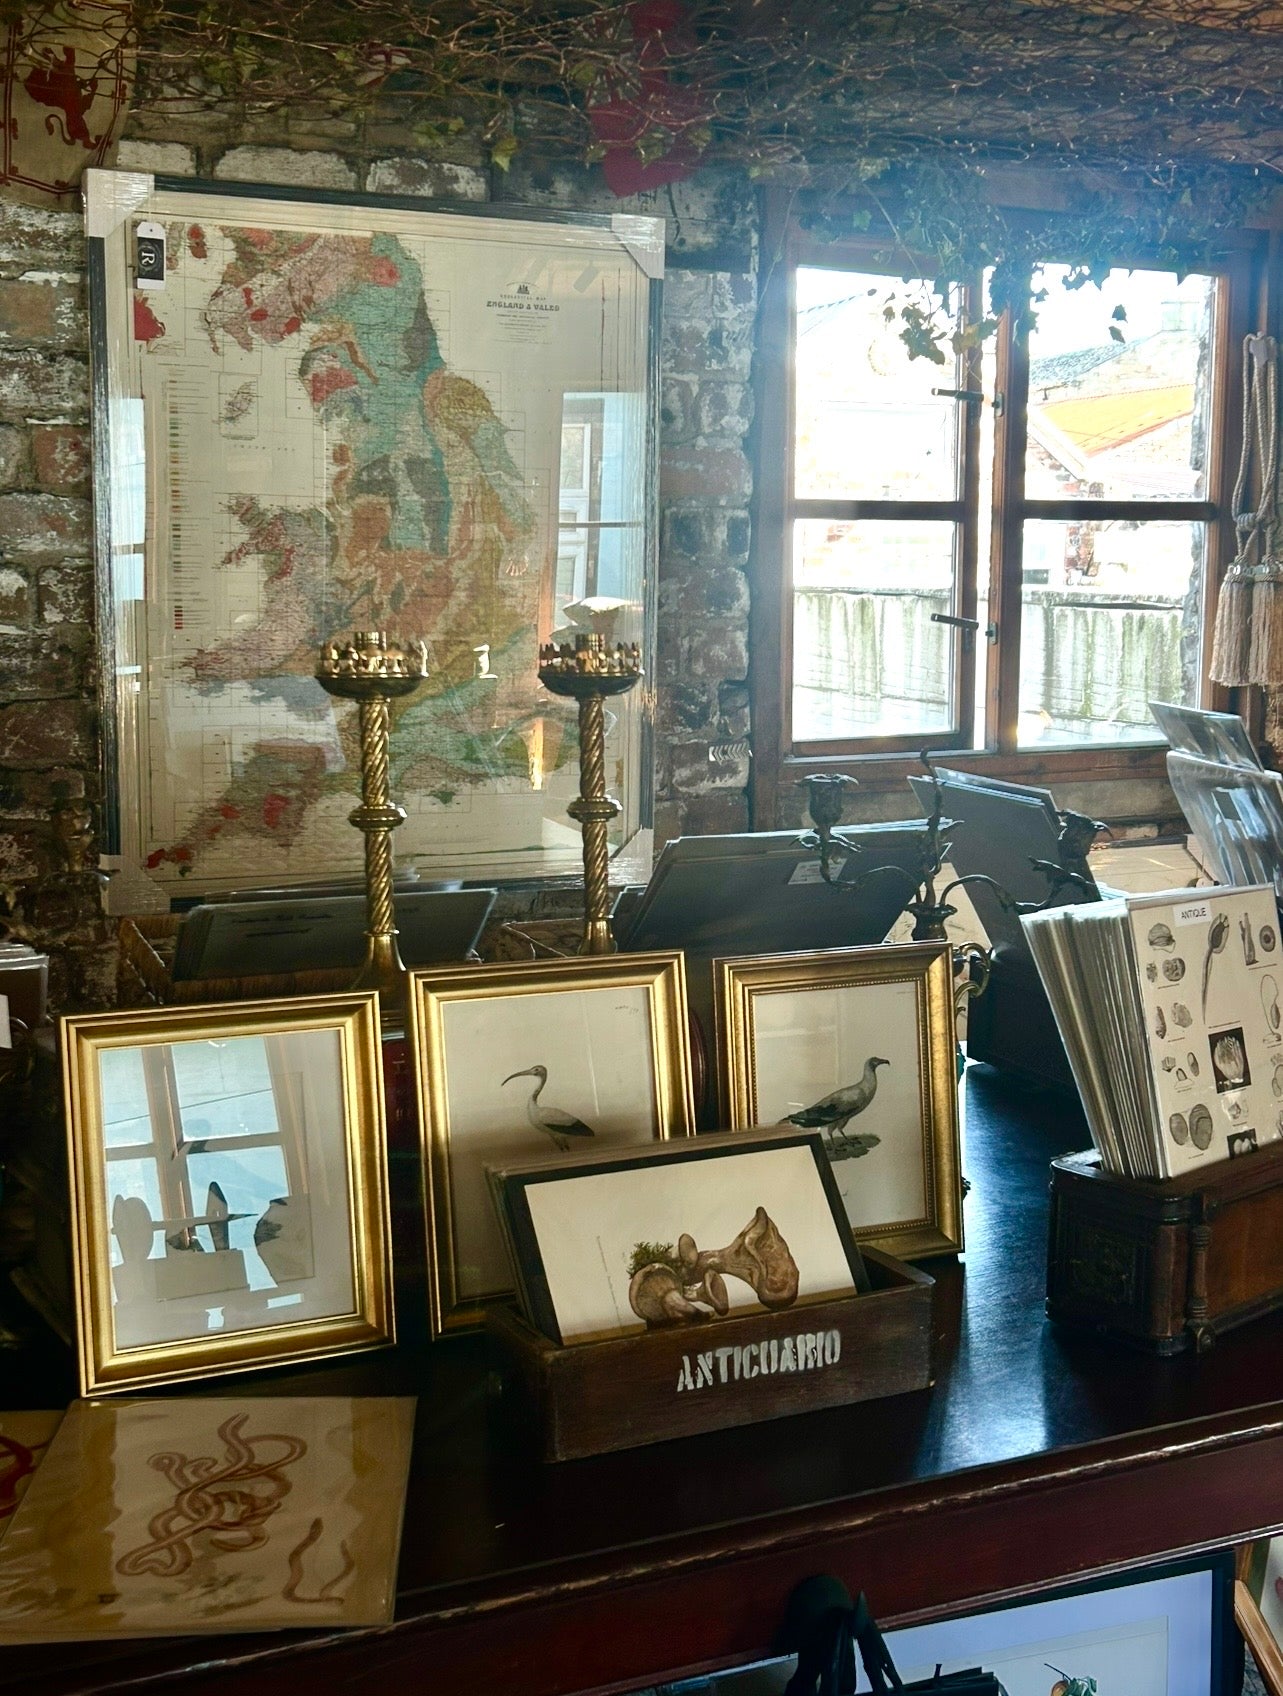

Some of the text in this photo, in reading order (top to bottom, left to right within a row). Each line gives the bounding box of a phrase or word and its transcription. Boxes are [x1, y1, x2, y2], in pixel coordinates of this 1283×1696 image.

[141, 251, 155, 265] R
[486, 300, 524, 310] ENGLAND
[1181, 907, 1207, 919] ANTIQUE
[676, 1329, 842, 1392] ANTICUARIO
